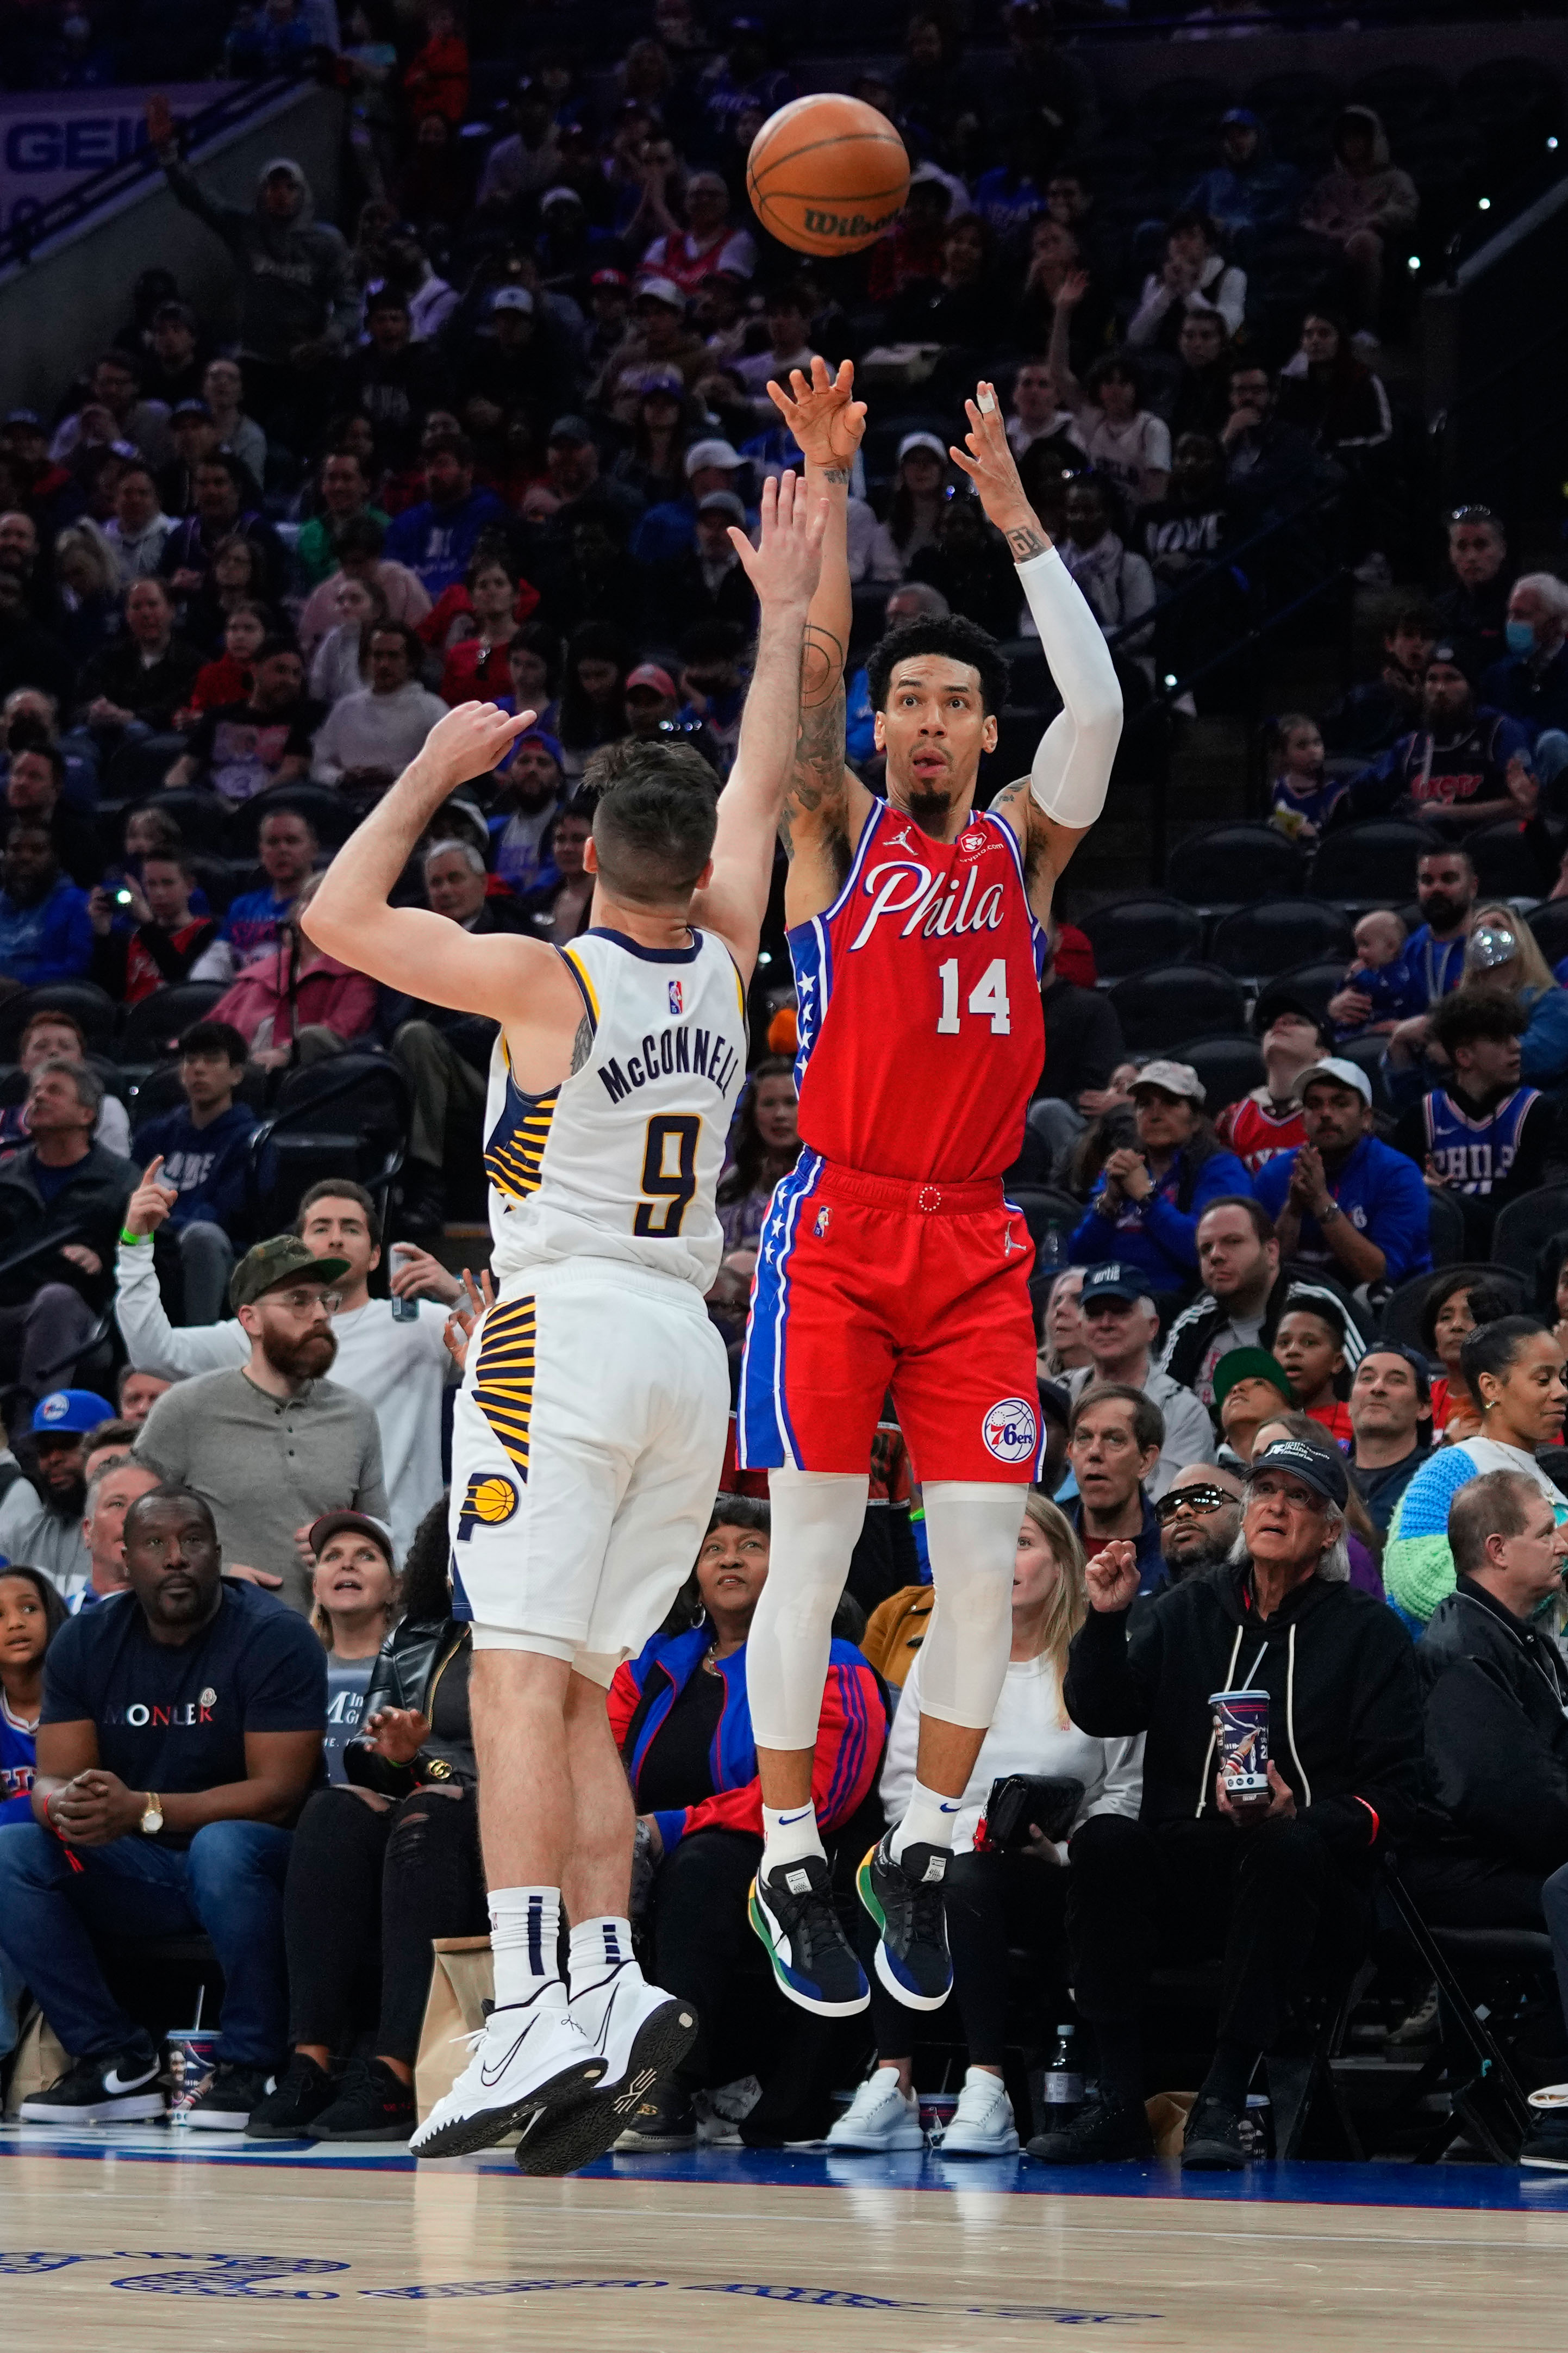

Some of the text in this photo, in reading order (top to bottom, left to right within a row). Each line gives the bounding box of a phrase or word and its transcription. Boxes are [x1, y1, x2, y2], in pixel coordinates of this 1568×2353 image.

[959, 843, 1004, 863] crypto.com
[847, 861, 1004, 953] Phila
[936, 958, 1011, 1035] 14
[597, 1026, 738, 1104] McCONNELL
[633, 1113, 703, 1238] 9
[990, 1423, 1033, 1446] 76ers
